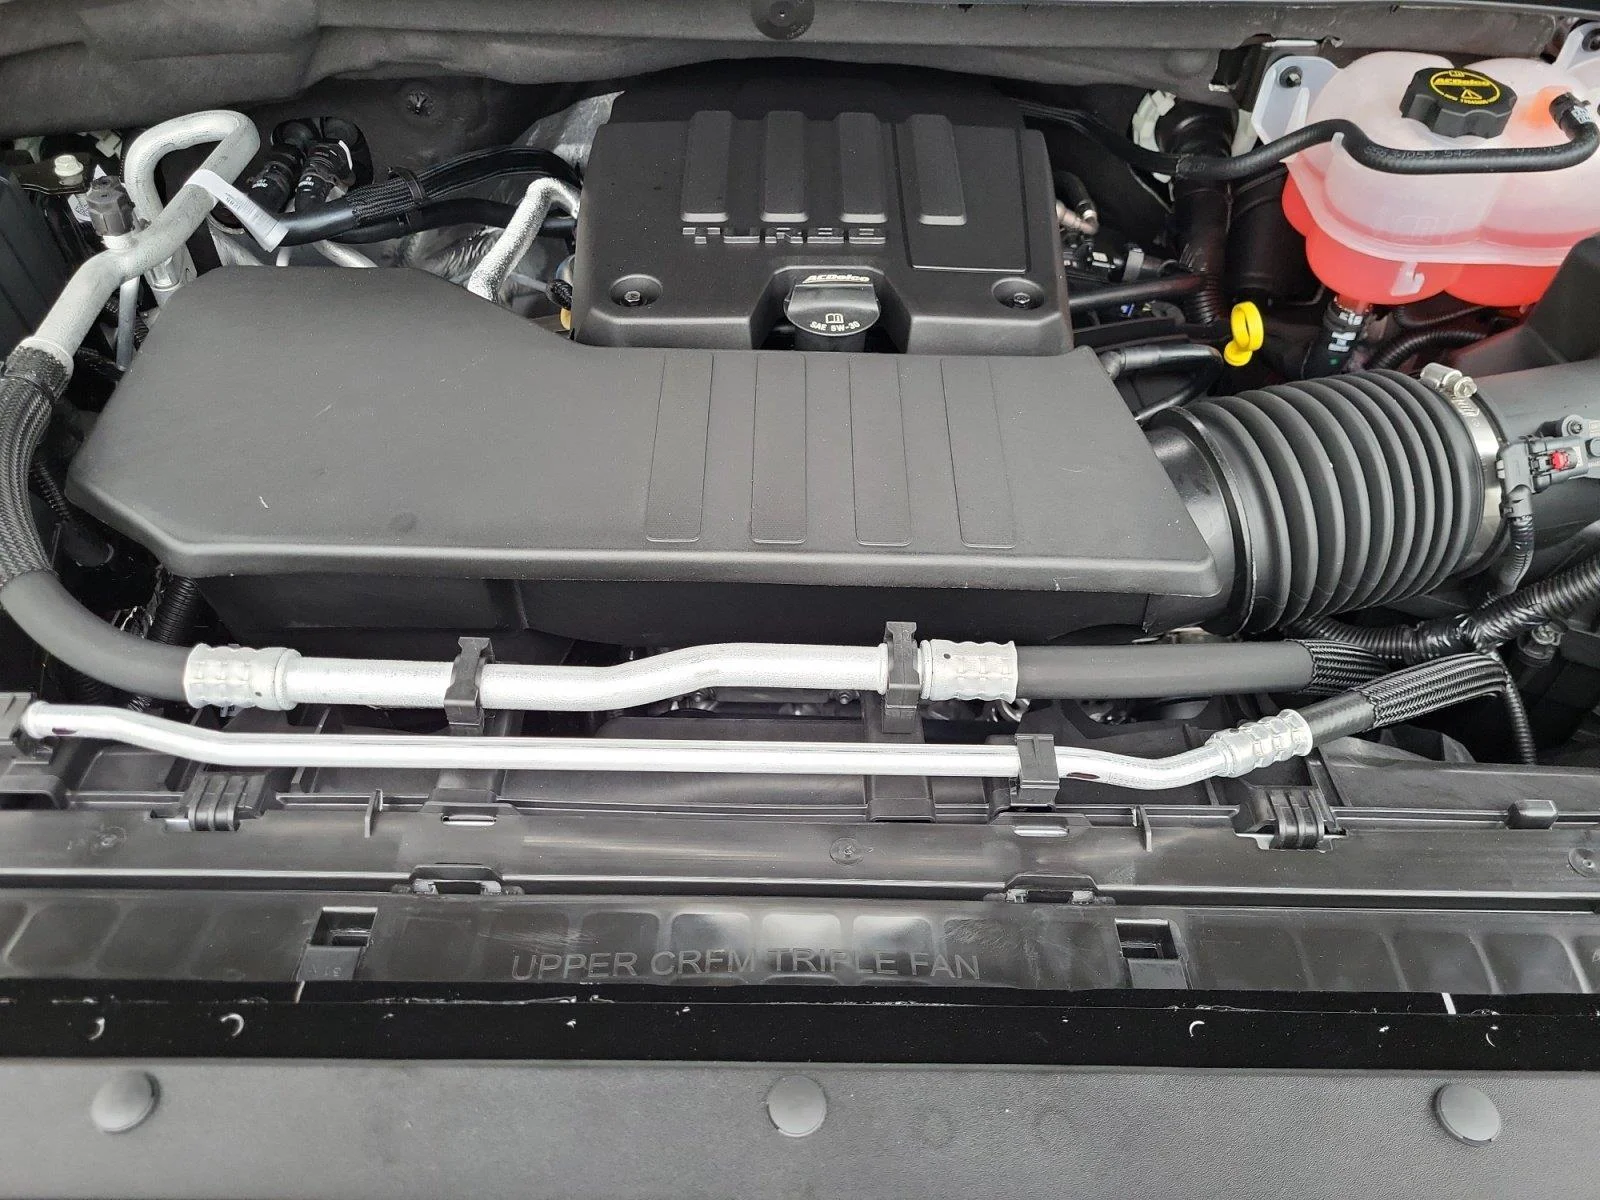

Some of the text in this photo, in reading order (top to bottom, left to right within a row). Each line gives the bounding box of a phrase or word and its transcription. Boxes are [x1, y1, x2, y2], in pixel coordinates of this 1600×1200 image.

[683, 227, 886, 244] TURBO
[802, 274, 870, 284] ACDelco
[810, 321, 860, 332] SAE 5W-30
[512, 948, 981, 981] UPPER CRFM TRIPLE FAN
